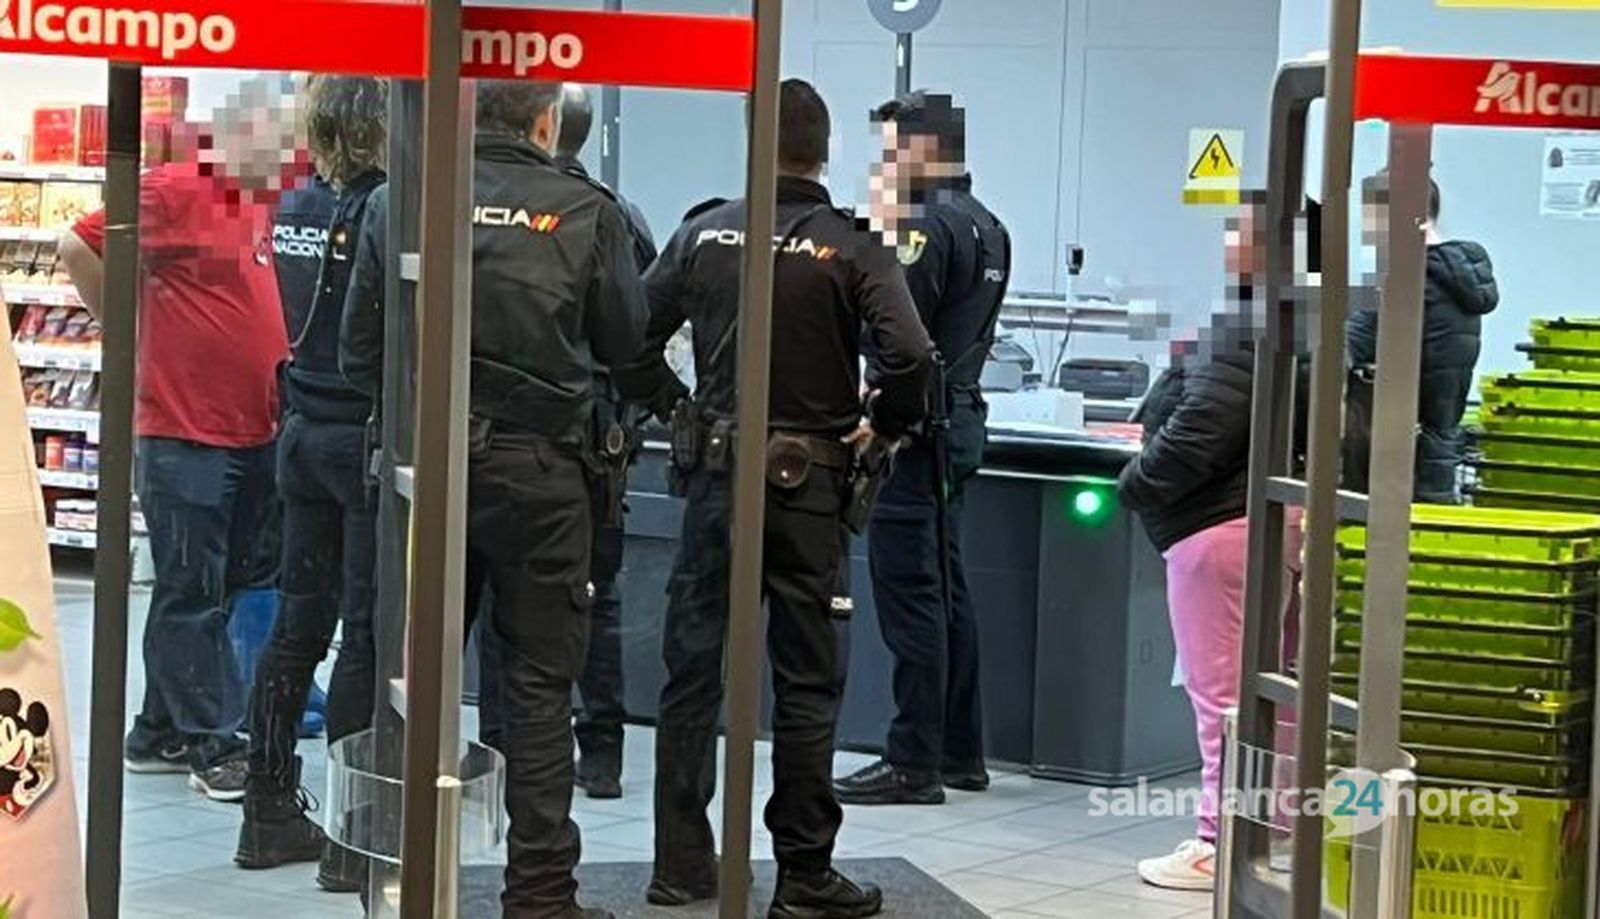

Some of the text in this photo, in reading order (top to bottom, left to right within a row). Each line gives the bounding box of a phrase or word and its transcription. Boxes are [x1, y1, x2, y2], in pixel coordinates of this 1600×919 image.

[1474, 61, 1600, 117] Alca
[473, 206, 530, 226] ICIA
[272, 239, 347, 260] NACIONL
[696, 229, 817, 257] POCIA
